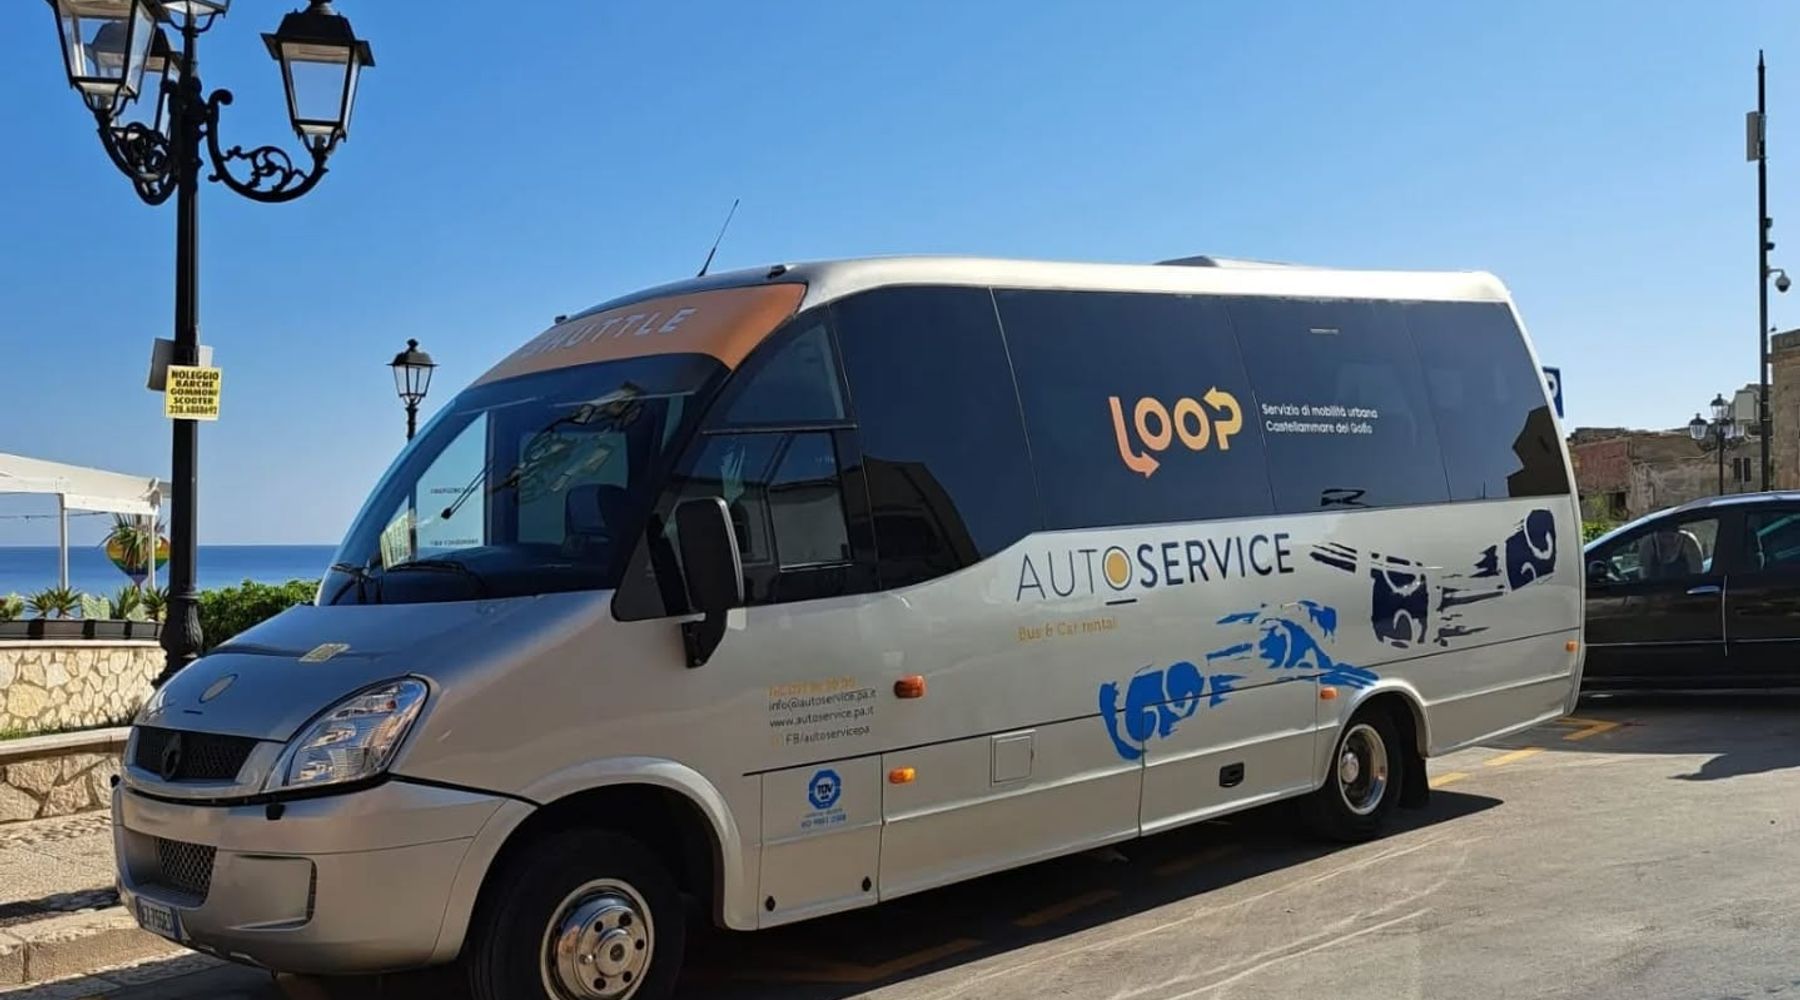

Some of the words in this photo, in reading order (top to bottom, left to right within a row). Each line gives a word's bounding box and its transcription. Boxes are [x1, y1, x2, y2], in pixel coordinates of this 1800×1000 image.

[521, 308, 698, 356] HUTTLE
[171, 370, 219, 380] NOLEGGIO
[175, 380, 214, 388] BARCHE
[173, 397, 214, 405] SCOOTER
[1261, 403, 1300, 416] Servizio
[1301, 404, 1310, 416] di
[1347, 408, 1379, 419] urbana
[1108, 386, 1243, 478] LOOP
[1265, 420, 1335, 433] Castellammare
[1335, 422, 1349, 434] del
[1350, 422, 1373, 435] Golfo
[1016, 533, 1294, 602] AUTOSERVICE
[1018, 625, 1041, 641] Bus
[1057, 621, 1077, 636] Car
[1082, 616, 1118, 633] rental
[769, 706, 875, 728] www.autoservice.pa.it
[785, 725, 870, 744] FB/autoservicepa
